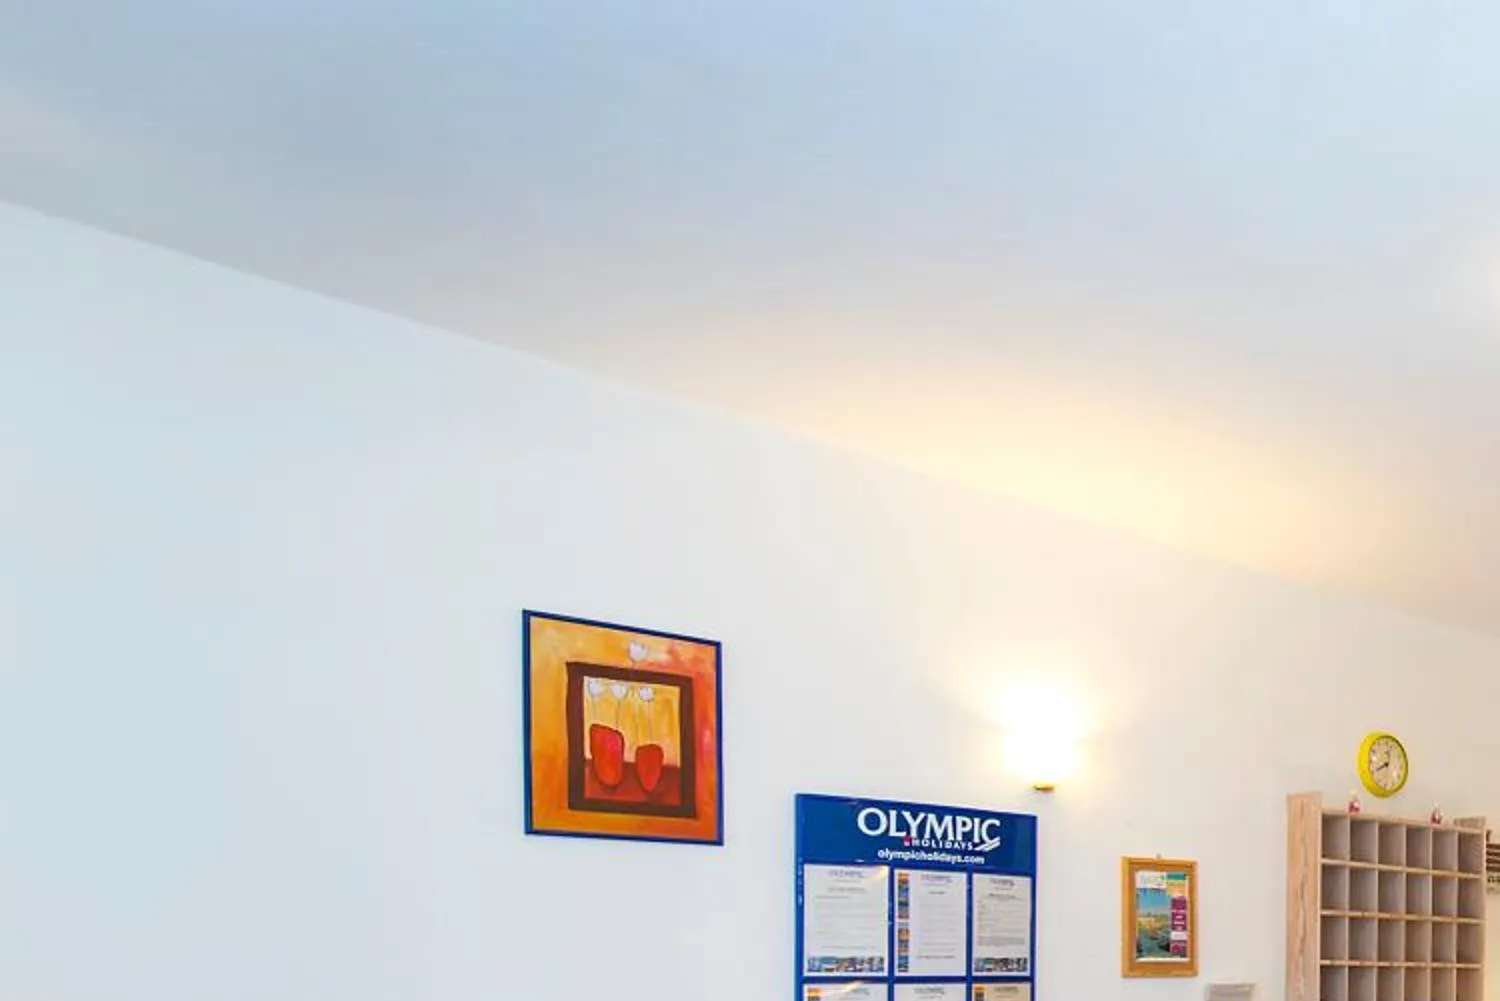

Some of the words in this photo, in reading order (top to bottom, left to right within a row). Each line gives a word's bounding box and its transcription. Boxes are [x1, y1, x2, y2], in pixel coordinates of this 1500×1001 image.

[857, 807, 1000, 847] OLYMPIC
[911, 838, 973, 851] HOLIDAYS
[877, 848, 985, 864] olympicholidays.com
